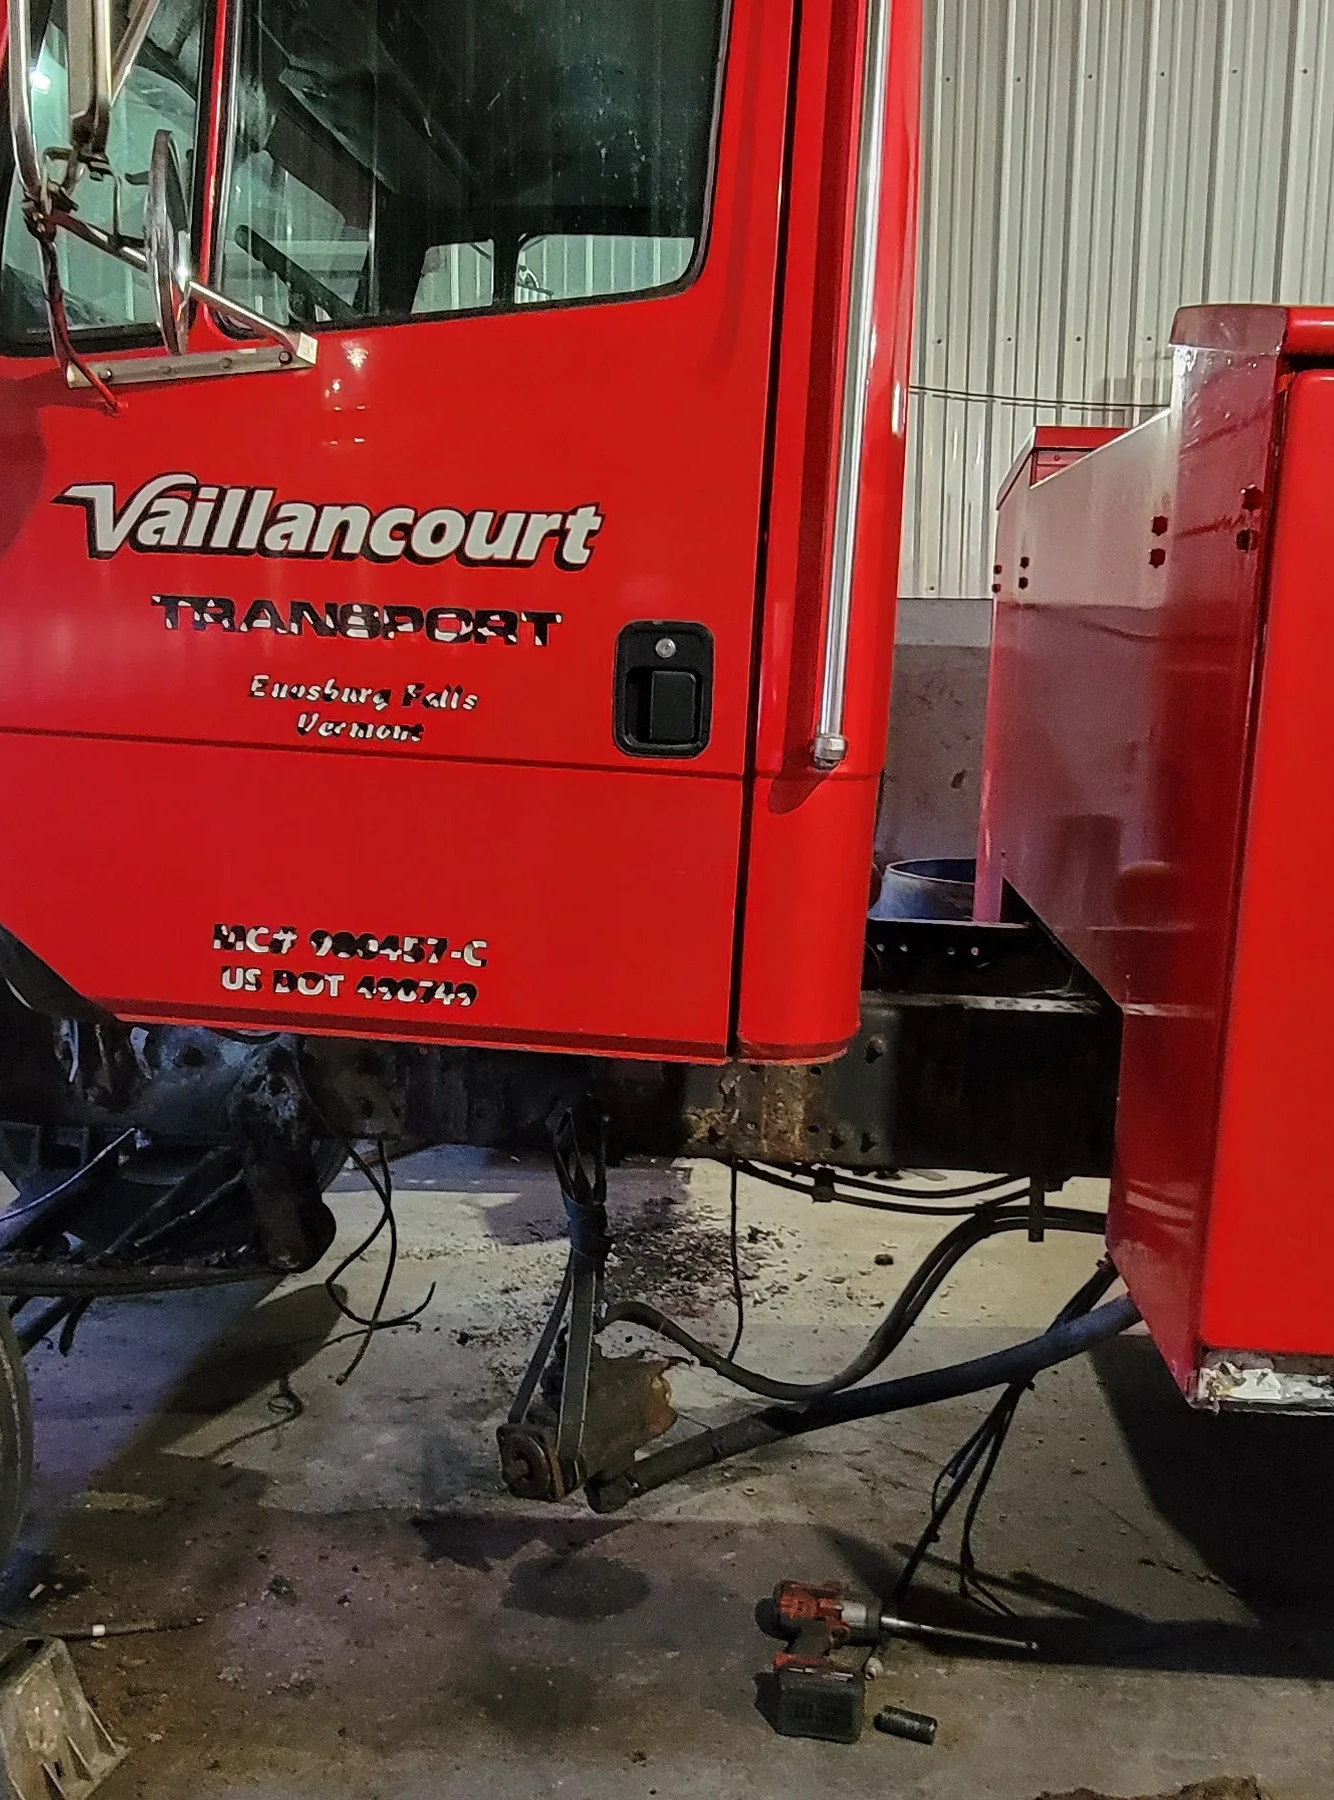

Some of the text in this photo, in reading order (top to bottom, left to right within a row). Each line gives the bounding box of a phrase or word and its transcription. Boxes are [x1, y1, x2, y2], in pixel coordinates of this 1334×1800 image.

[50, 472, 605, 571] Vaillancourt
[150, 593, 563, 647] TRANSPORT
[400, 682, 480, 711] Falls
[297, 711, 425, 743] Vermont
[213, 923, 298, 955] MC#
[221, 965, 263, 992] US
[273, 969, 345, 998] DOT
